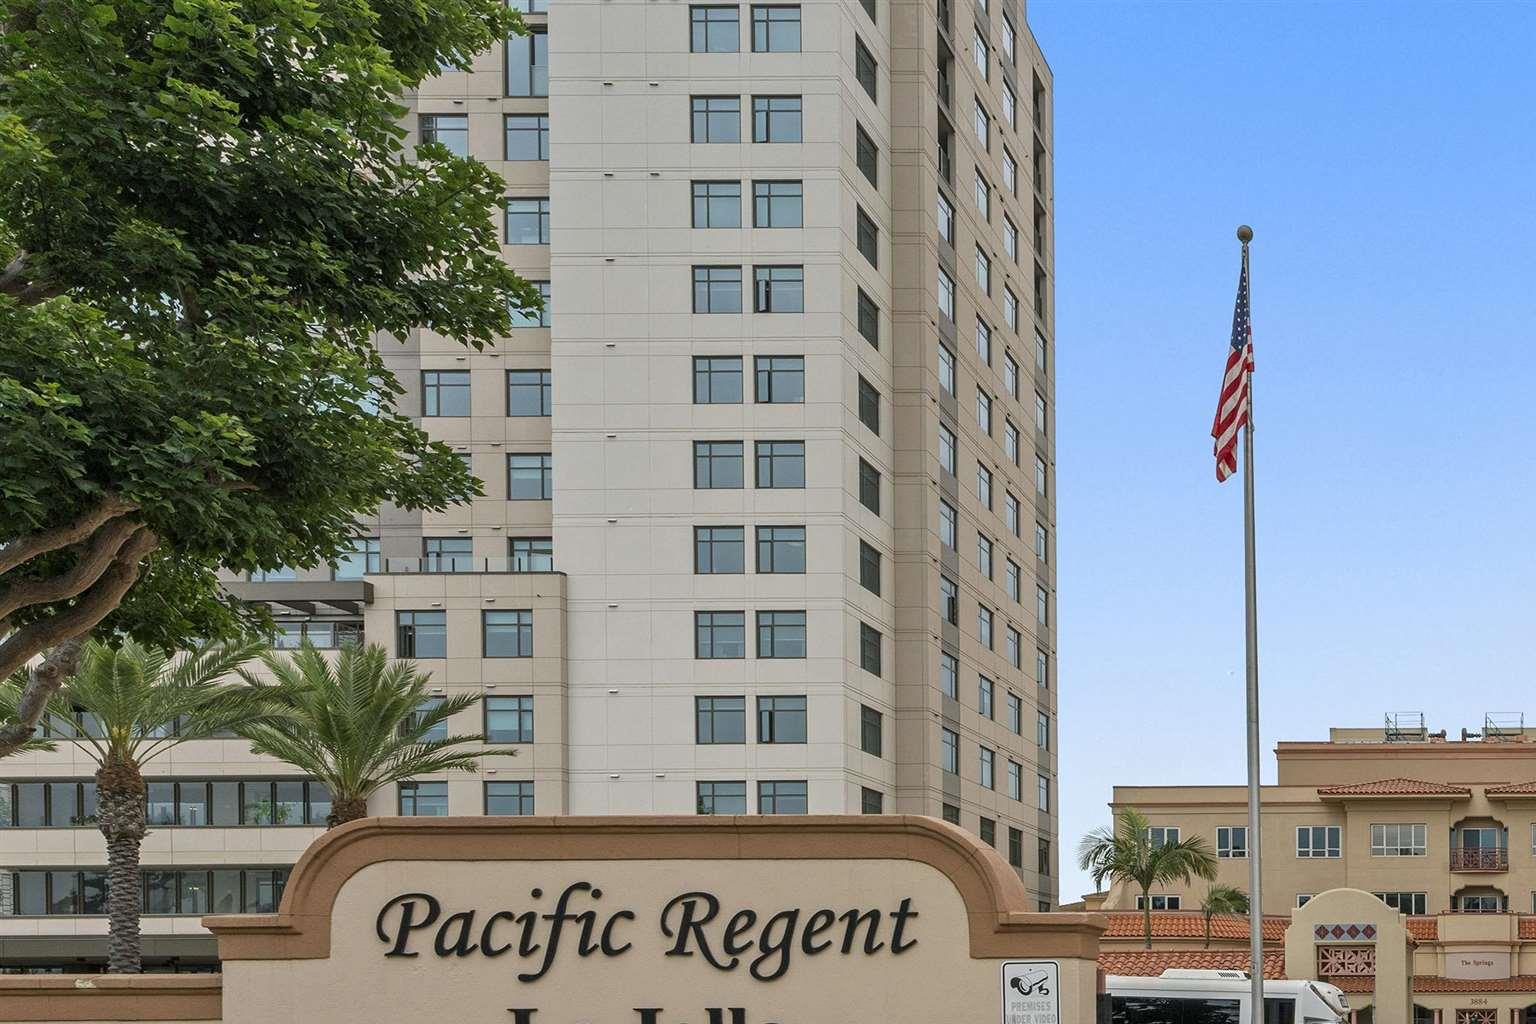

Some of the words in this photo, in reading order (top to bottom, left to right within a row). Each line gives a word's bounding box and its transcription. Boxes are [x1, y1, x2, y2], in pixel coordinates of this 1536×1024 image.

[376, 881, 634, 982] Pacific
[661, 891, 918, 980] Regent
[1011, 1002, 1051, 1012] PREMISES
[1007, 1014, 1033, 1024] UNDER
[1036, 1014, 1057, 1024] VIDEO
